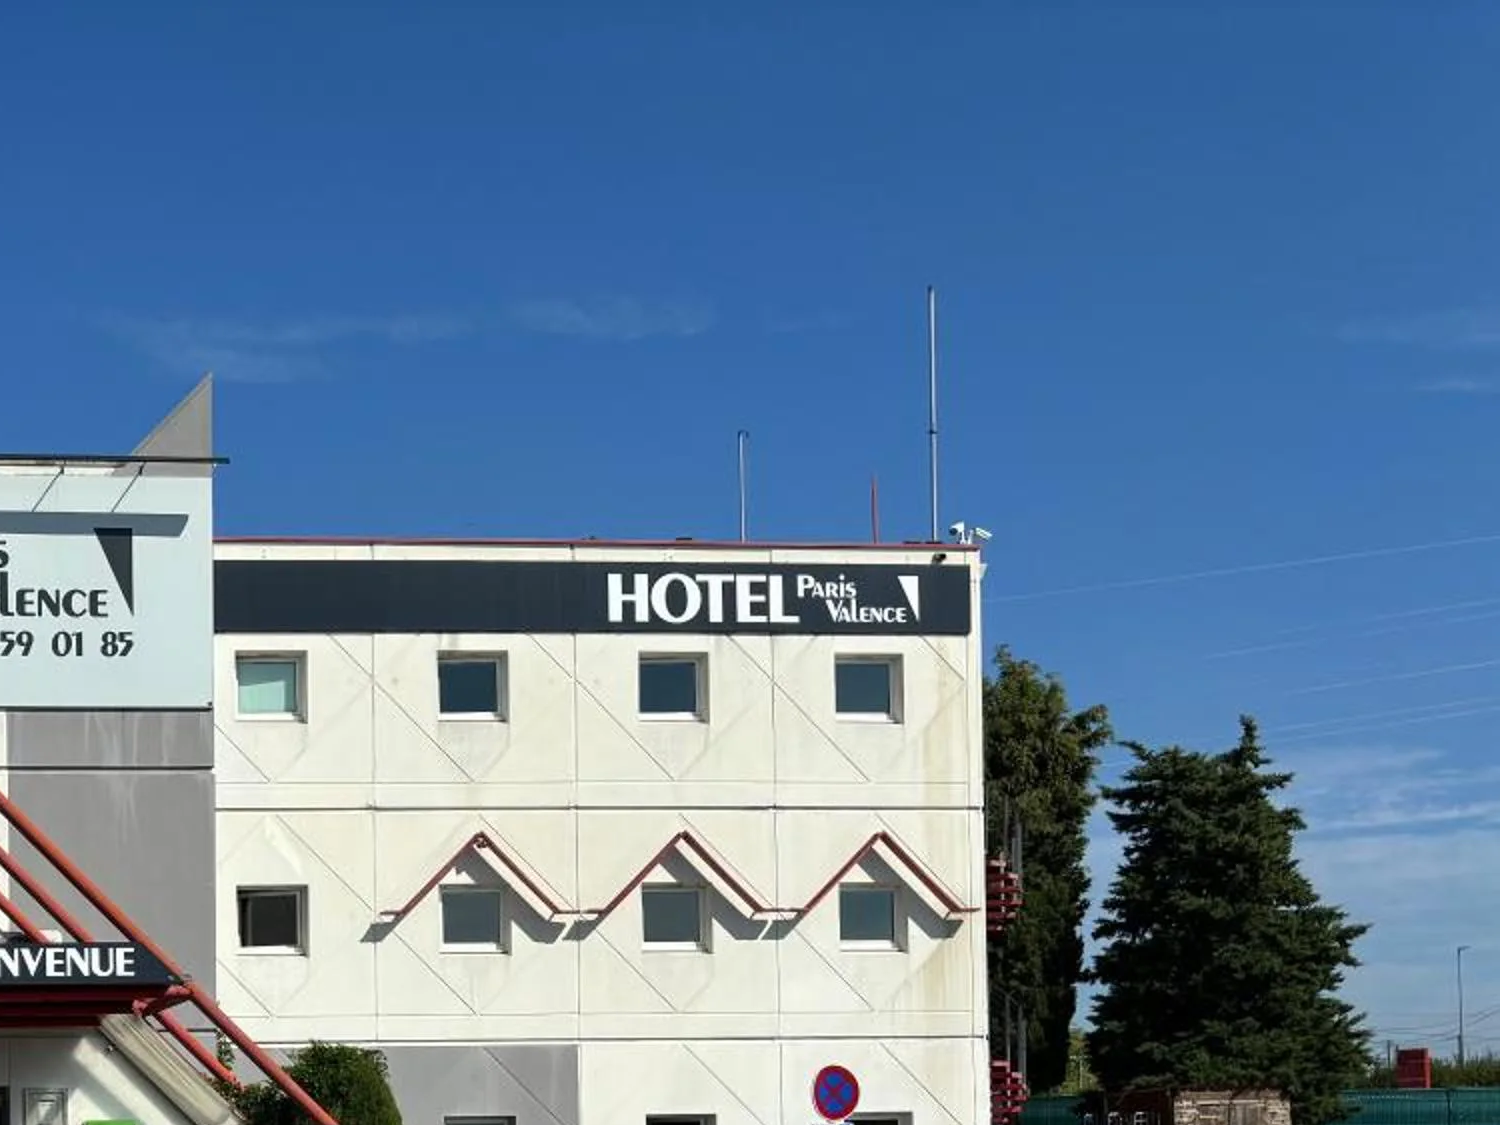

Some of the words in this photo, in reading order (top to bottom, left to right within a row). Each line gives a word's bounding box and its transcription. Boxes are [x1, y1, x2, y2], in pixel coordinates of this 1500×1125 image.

[607, 573, 799, 623] HOTEL
[0, 631, 33, 657] 59
[52, 631, 83, 657] 01
[101, 631, 134, 657] 85
